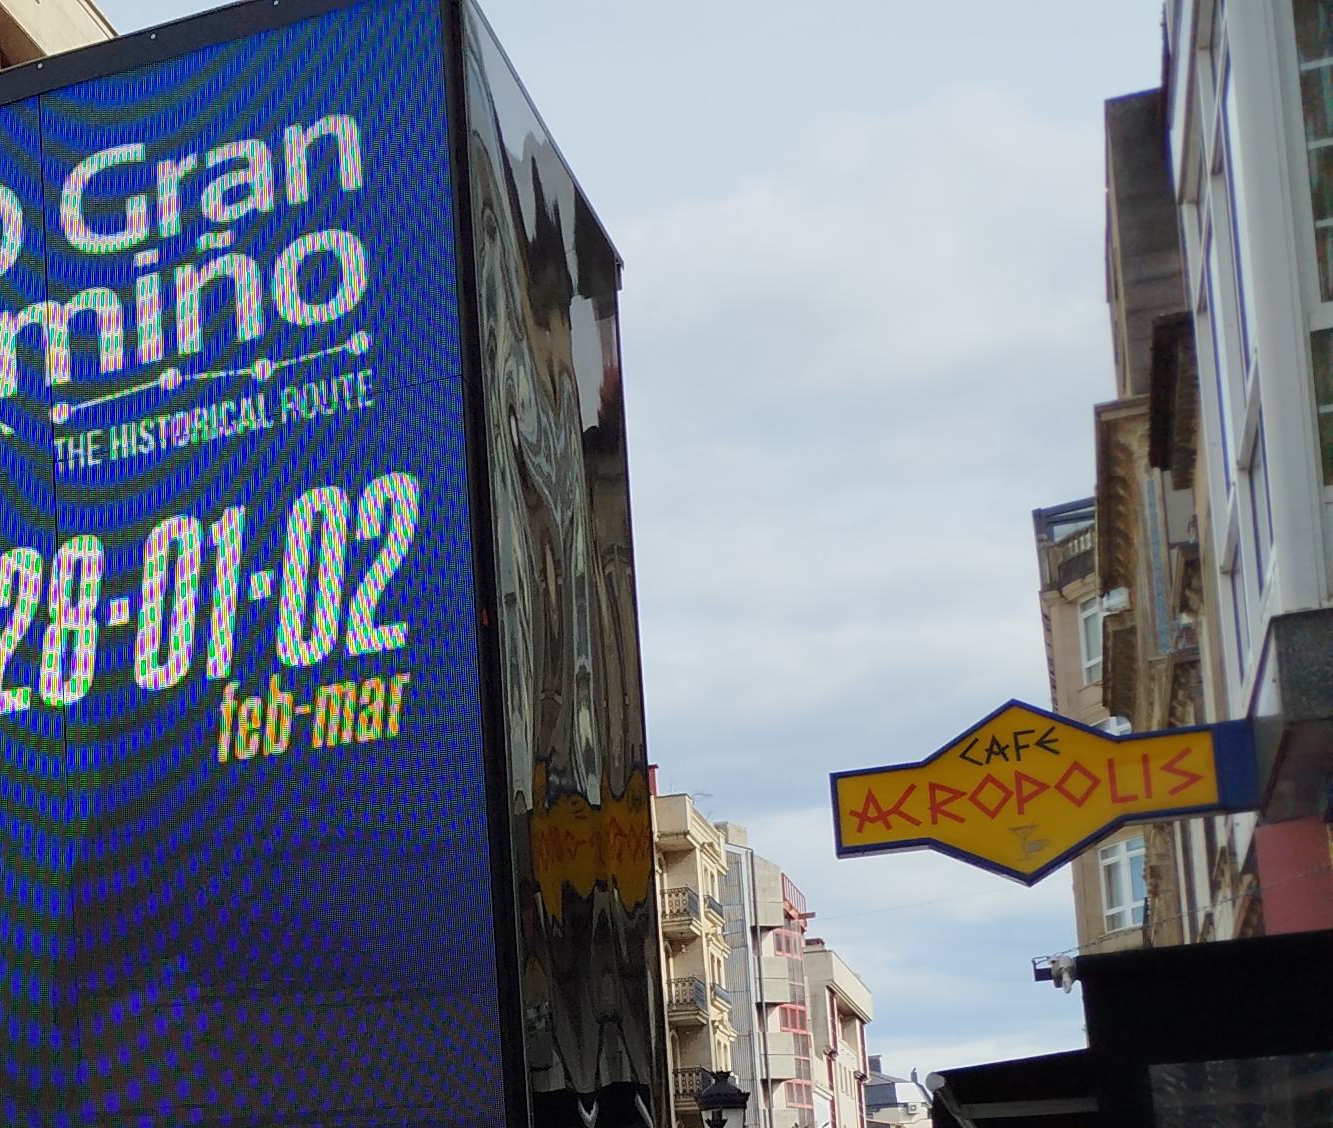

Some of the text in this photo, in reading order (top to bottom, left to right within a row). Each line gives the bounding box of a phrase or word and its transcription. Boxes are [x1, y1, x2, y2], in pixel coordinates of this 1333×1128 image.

[60, 114, 363, 253] Gran
[54, 370, 374, 471] THE HISTORICAL ROUTE
[219, 672, 410, 762] feb-mar
[959, 726, 1060, 766] CAFE
[849, 747, 1204, 833] ACROPOLIS
